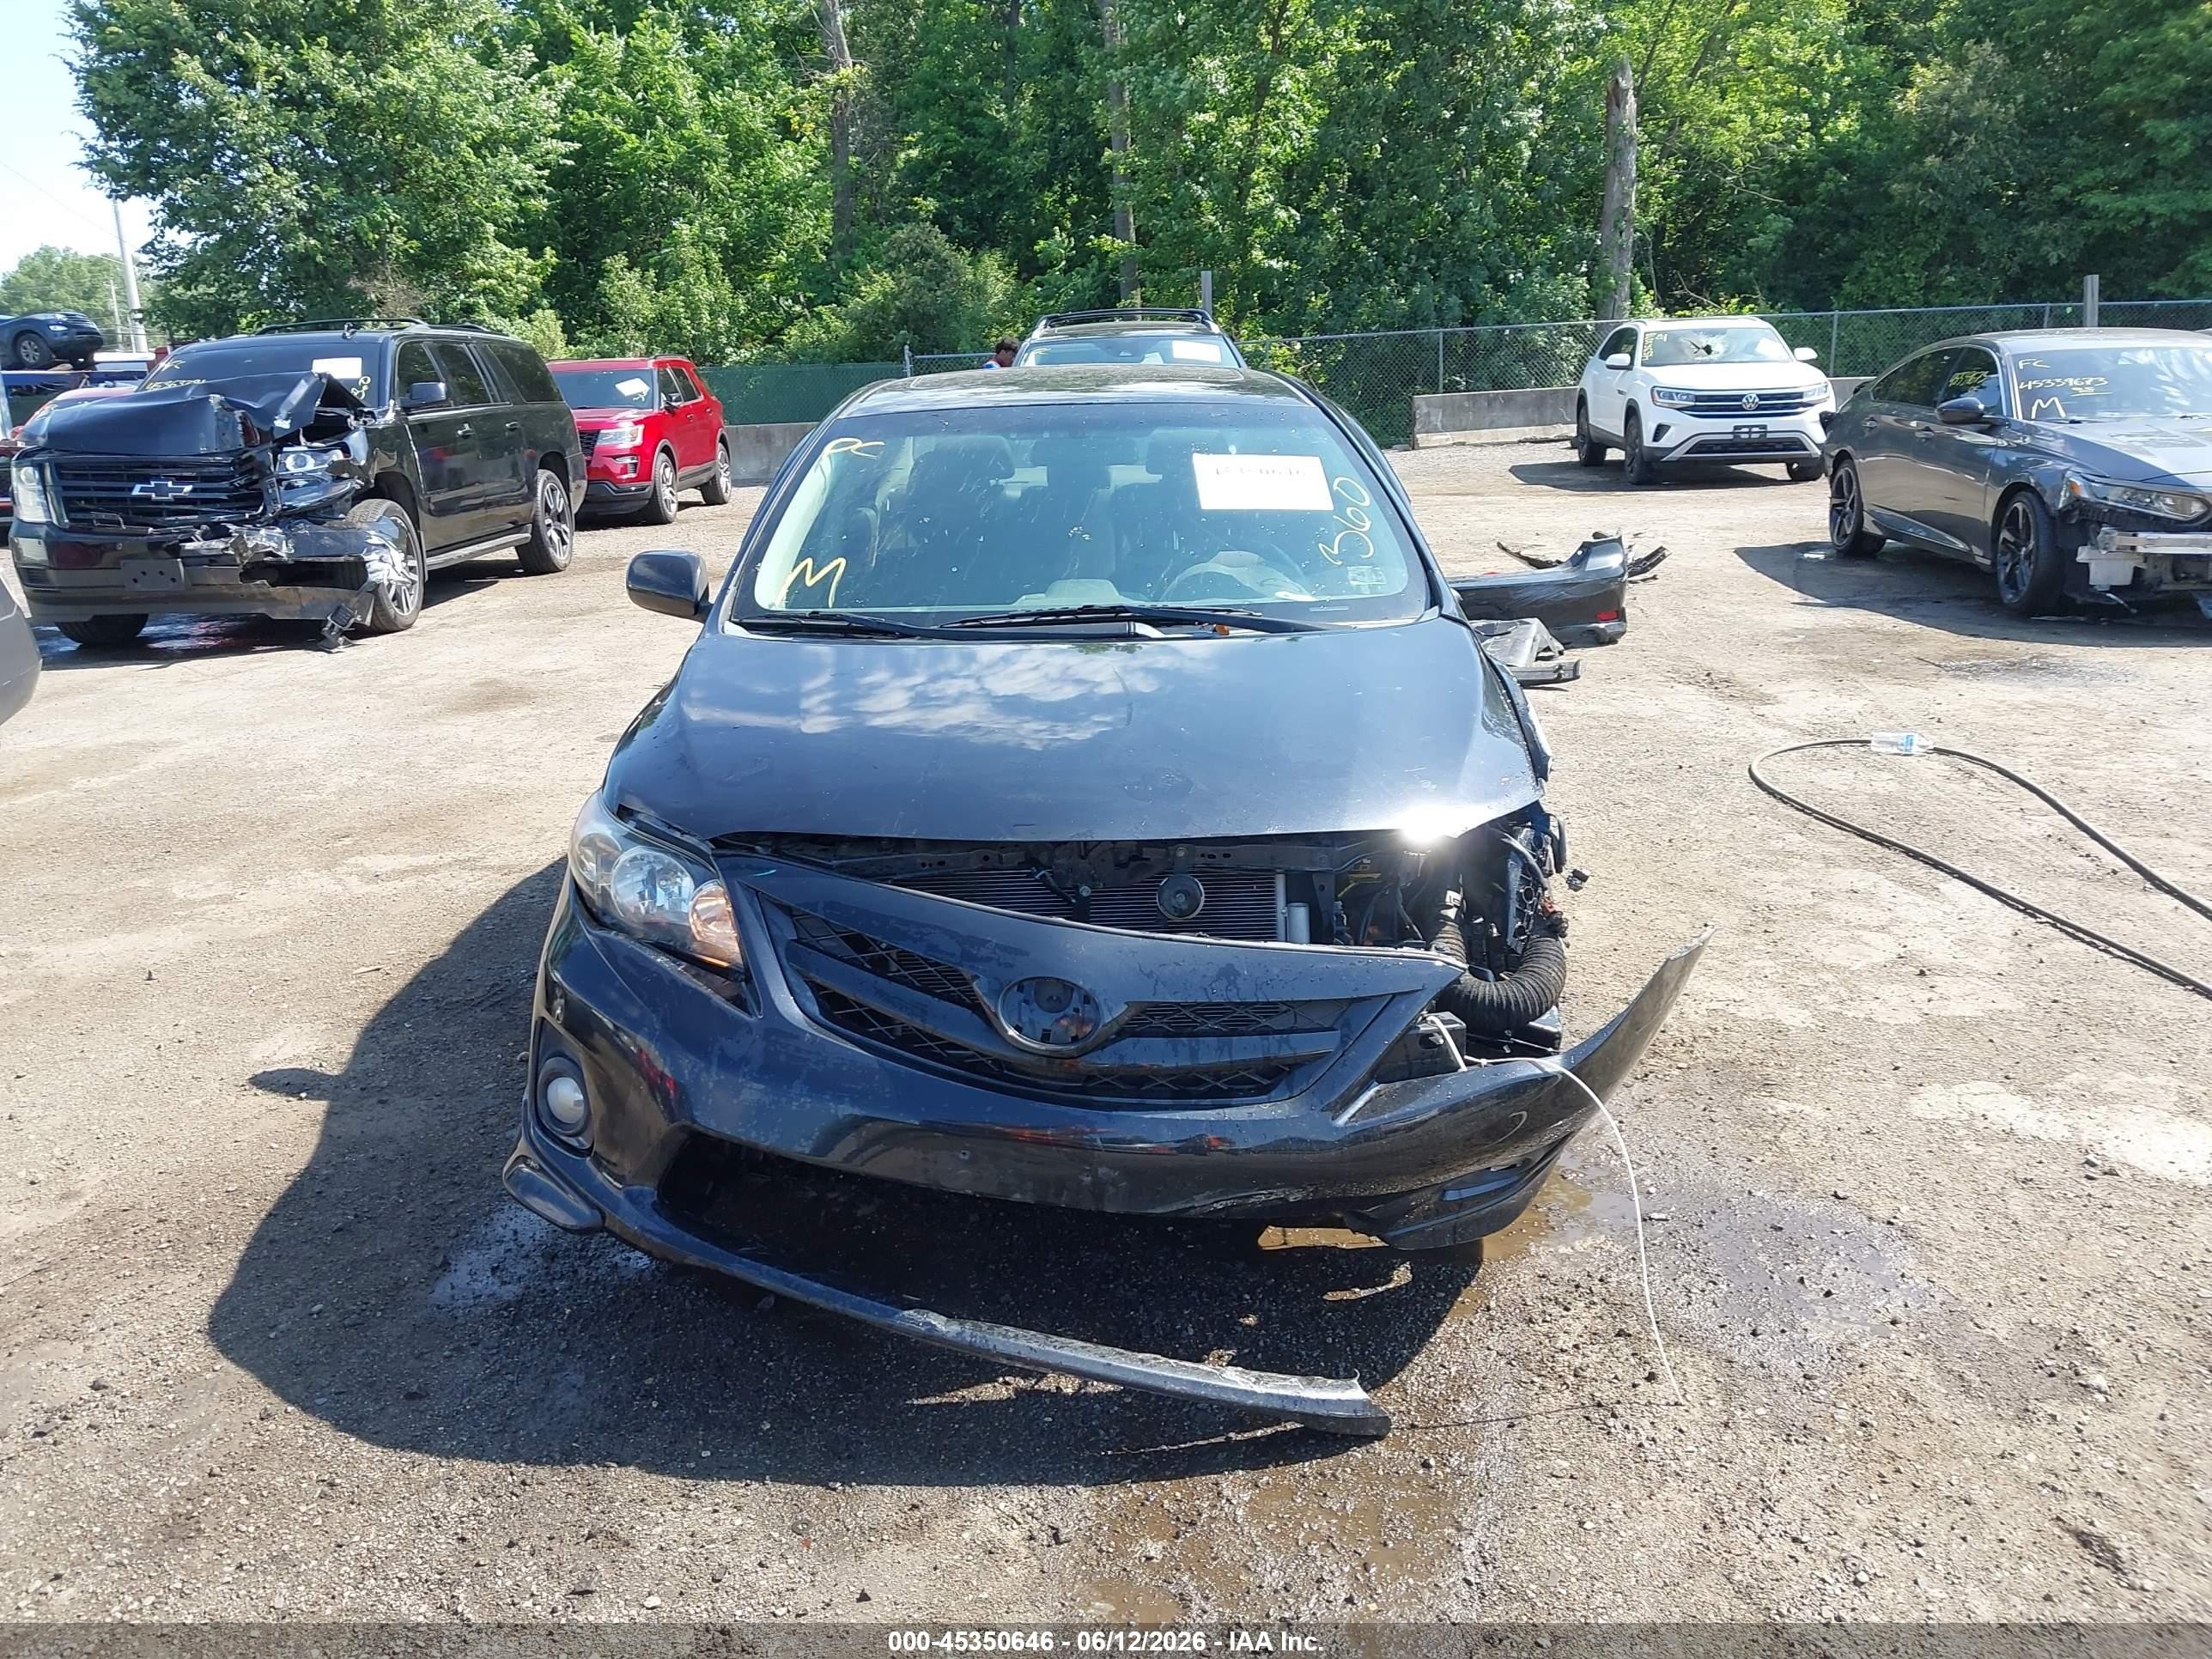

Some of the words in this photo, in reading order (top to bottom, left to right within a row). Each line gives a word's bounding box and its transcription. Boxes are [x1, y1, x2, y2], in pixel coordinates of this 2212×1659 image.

[2018, 358, 2051, 370] FC
[2019, 376, 2109, 390] 45339673
[2030, 397, 2067, 419] M
[1318, 477, 1374, 566] 360
[775, 556, 847, 609] M
